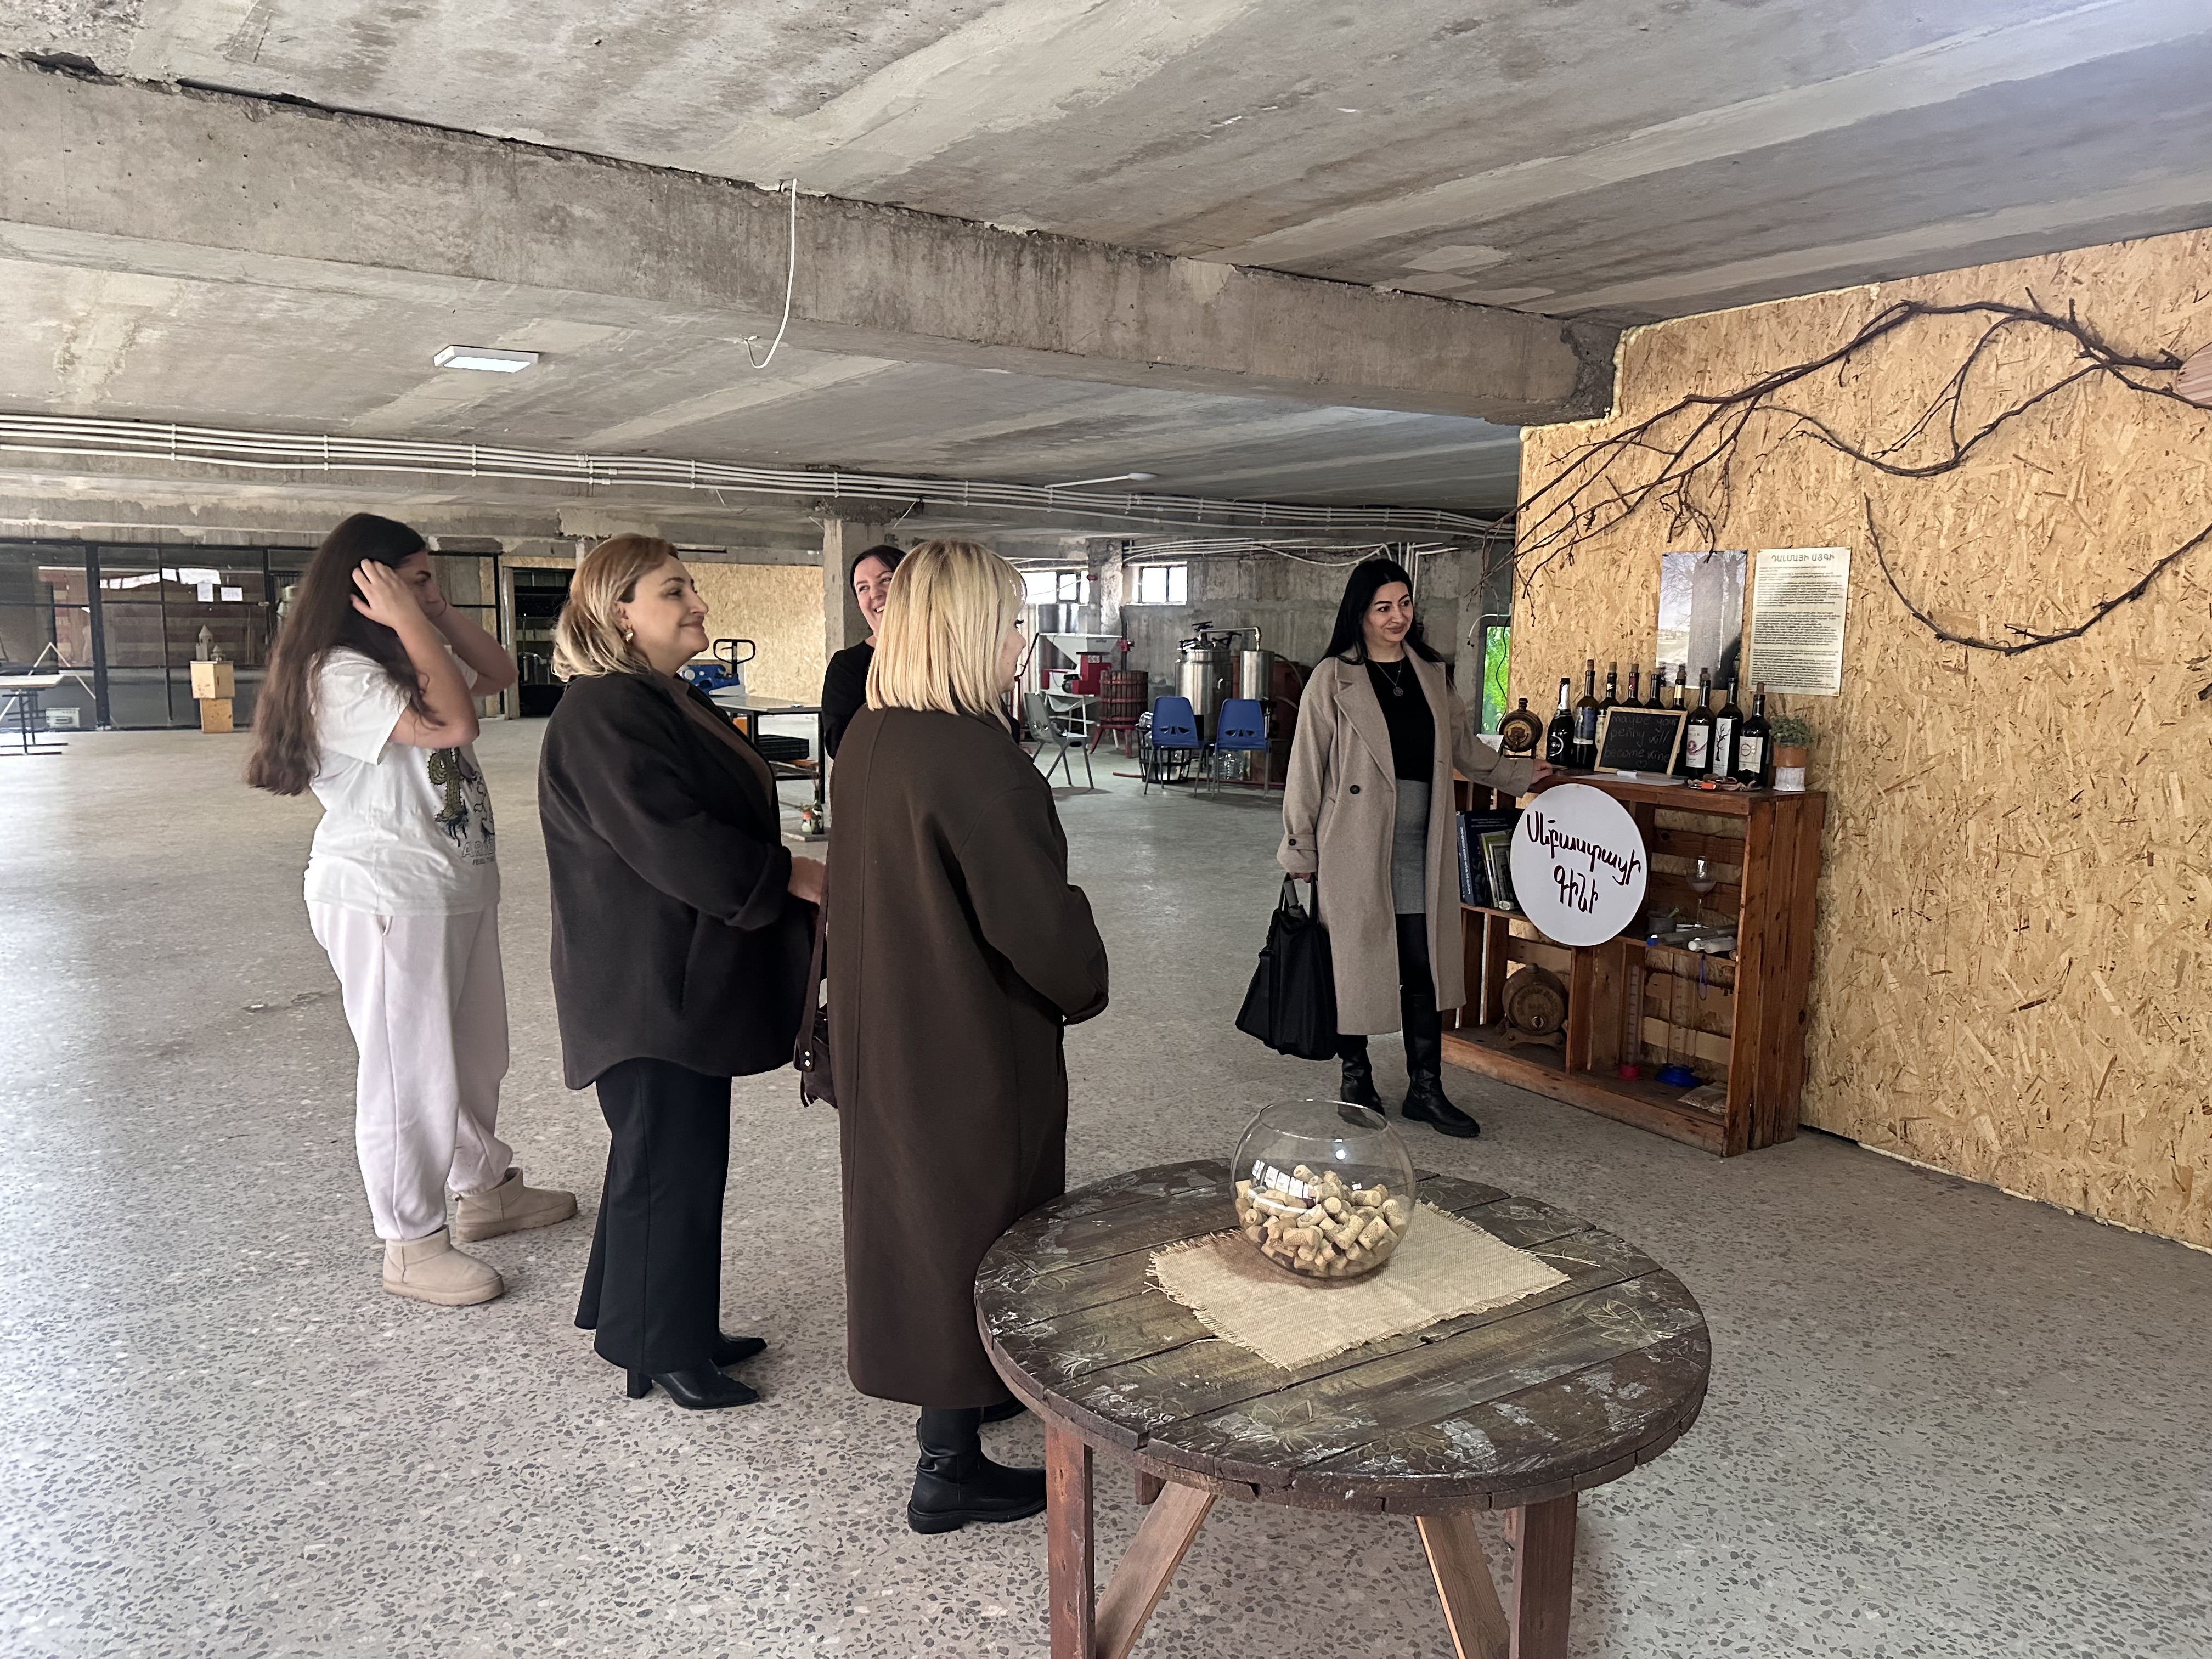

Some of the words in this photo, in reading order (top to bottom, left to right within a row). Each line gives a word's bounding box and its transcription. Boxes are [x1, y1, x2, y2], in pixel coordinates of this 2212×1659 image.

[1771, 554, 1809, 562] ԴԱԼՄԱՅԻ
[1812, 553, 1835, 561] ԱՅԳԻ
[1611, 715, 1651, 729] maybe
[1655, 718, 1679, 732] your
[1610, 728, 1645, 747] penny
[1604, 744, 1644, 758] become
